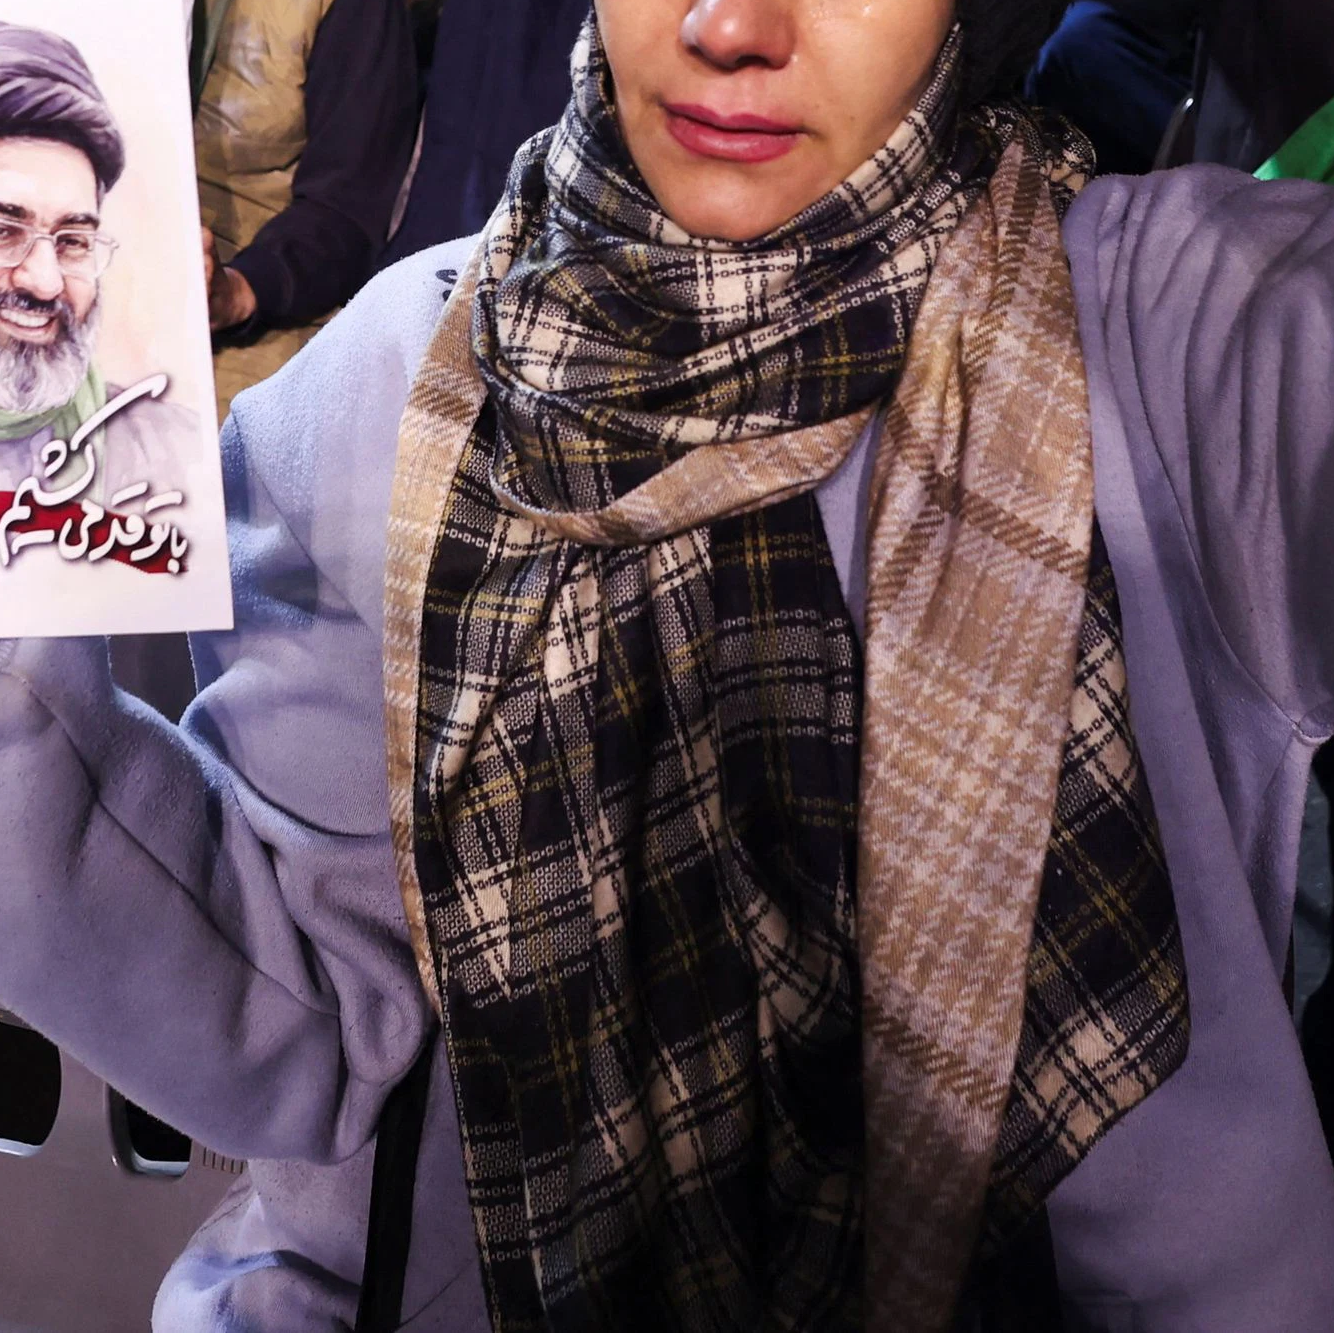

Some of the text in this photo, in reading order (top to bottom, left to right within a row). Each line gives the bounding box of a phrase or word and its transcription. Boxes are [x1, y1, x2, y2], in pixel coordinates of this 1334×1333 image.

[88, 482, 149, 563] قد
[130, 491, 183, 562] تو
[168, 526, 188, 573] با
